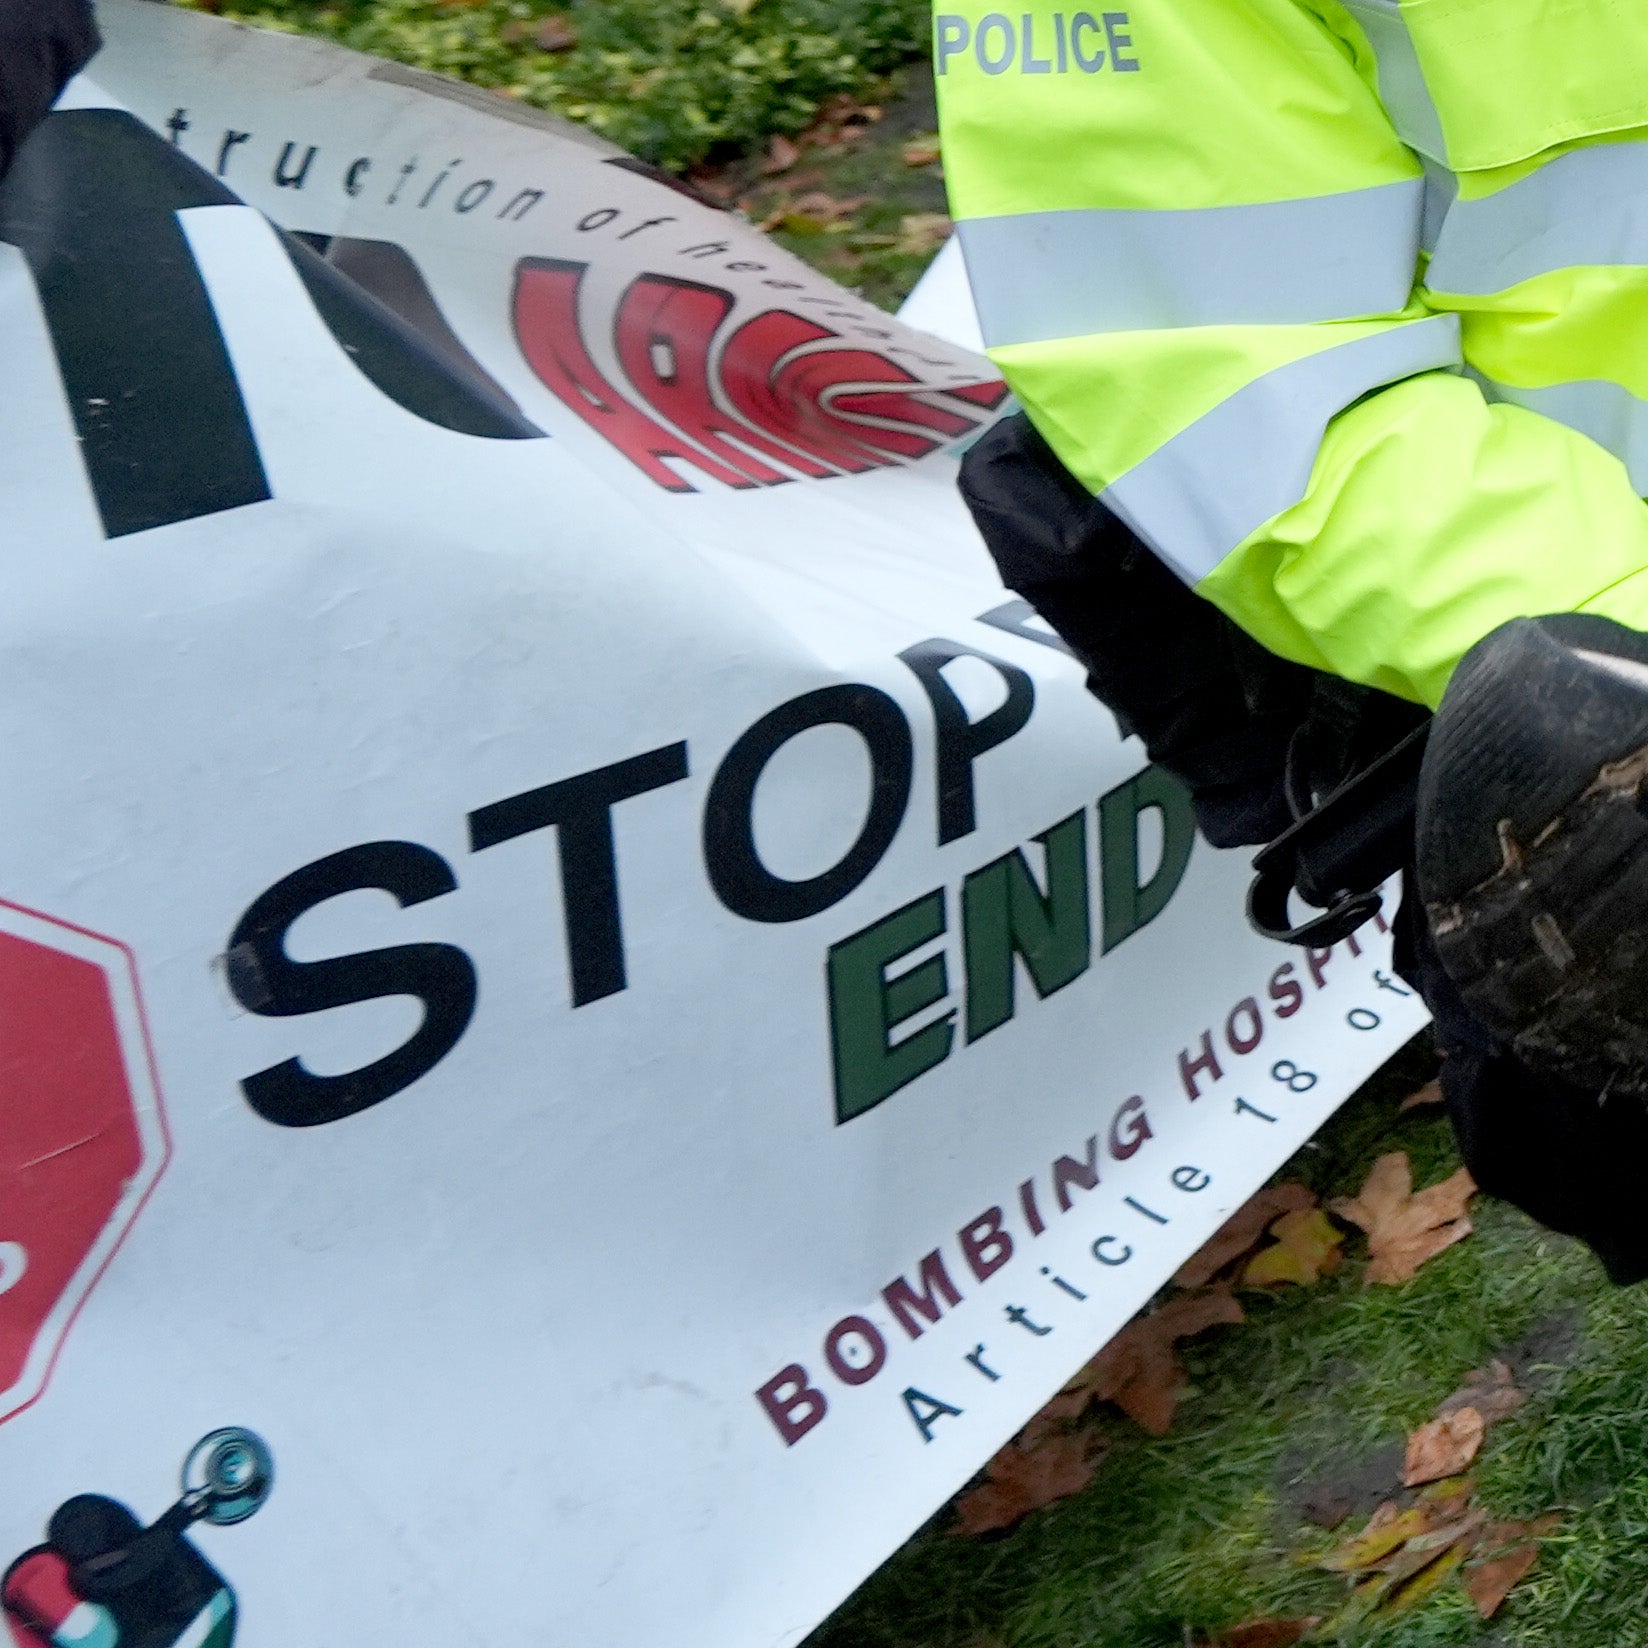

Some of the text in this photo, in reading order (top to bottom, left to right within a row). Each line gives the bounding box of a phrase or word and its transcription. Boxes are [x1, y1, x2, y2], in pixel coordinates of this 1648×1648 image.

[936, 10, 1141, 78] POLICE
[577, 206, 676, 241] of
[826, 763, 1197, 1125] END
[753, 1093, 1158, 1448] BOMBING
[902, 968, 1411, 1445] Article 18 of
